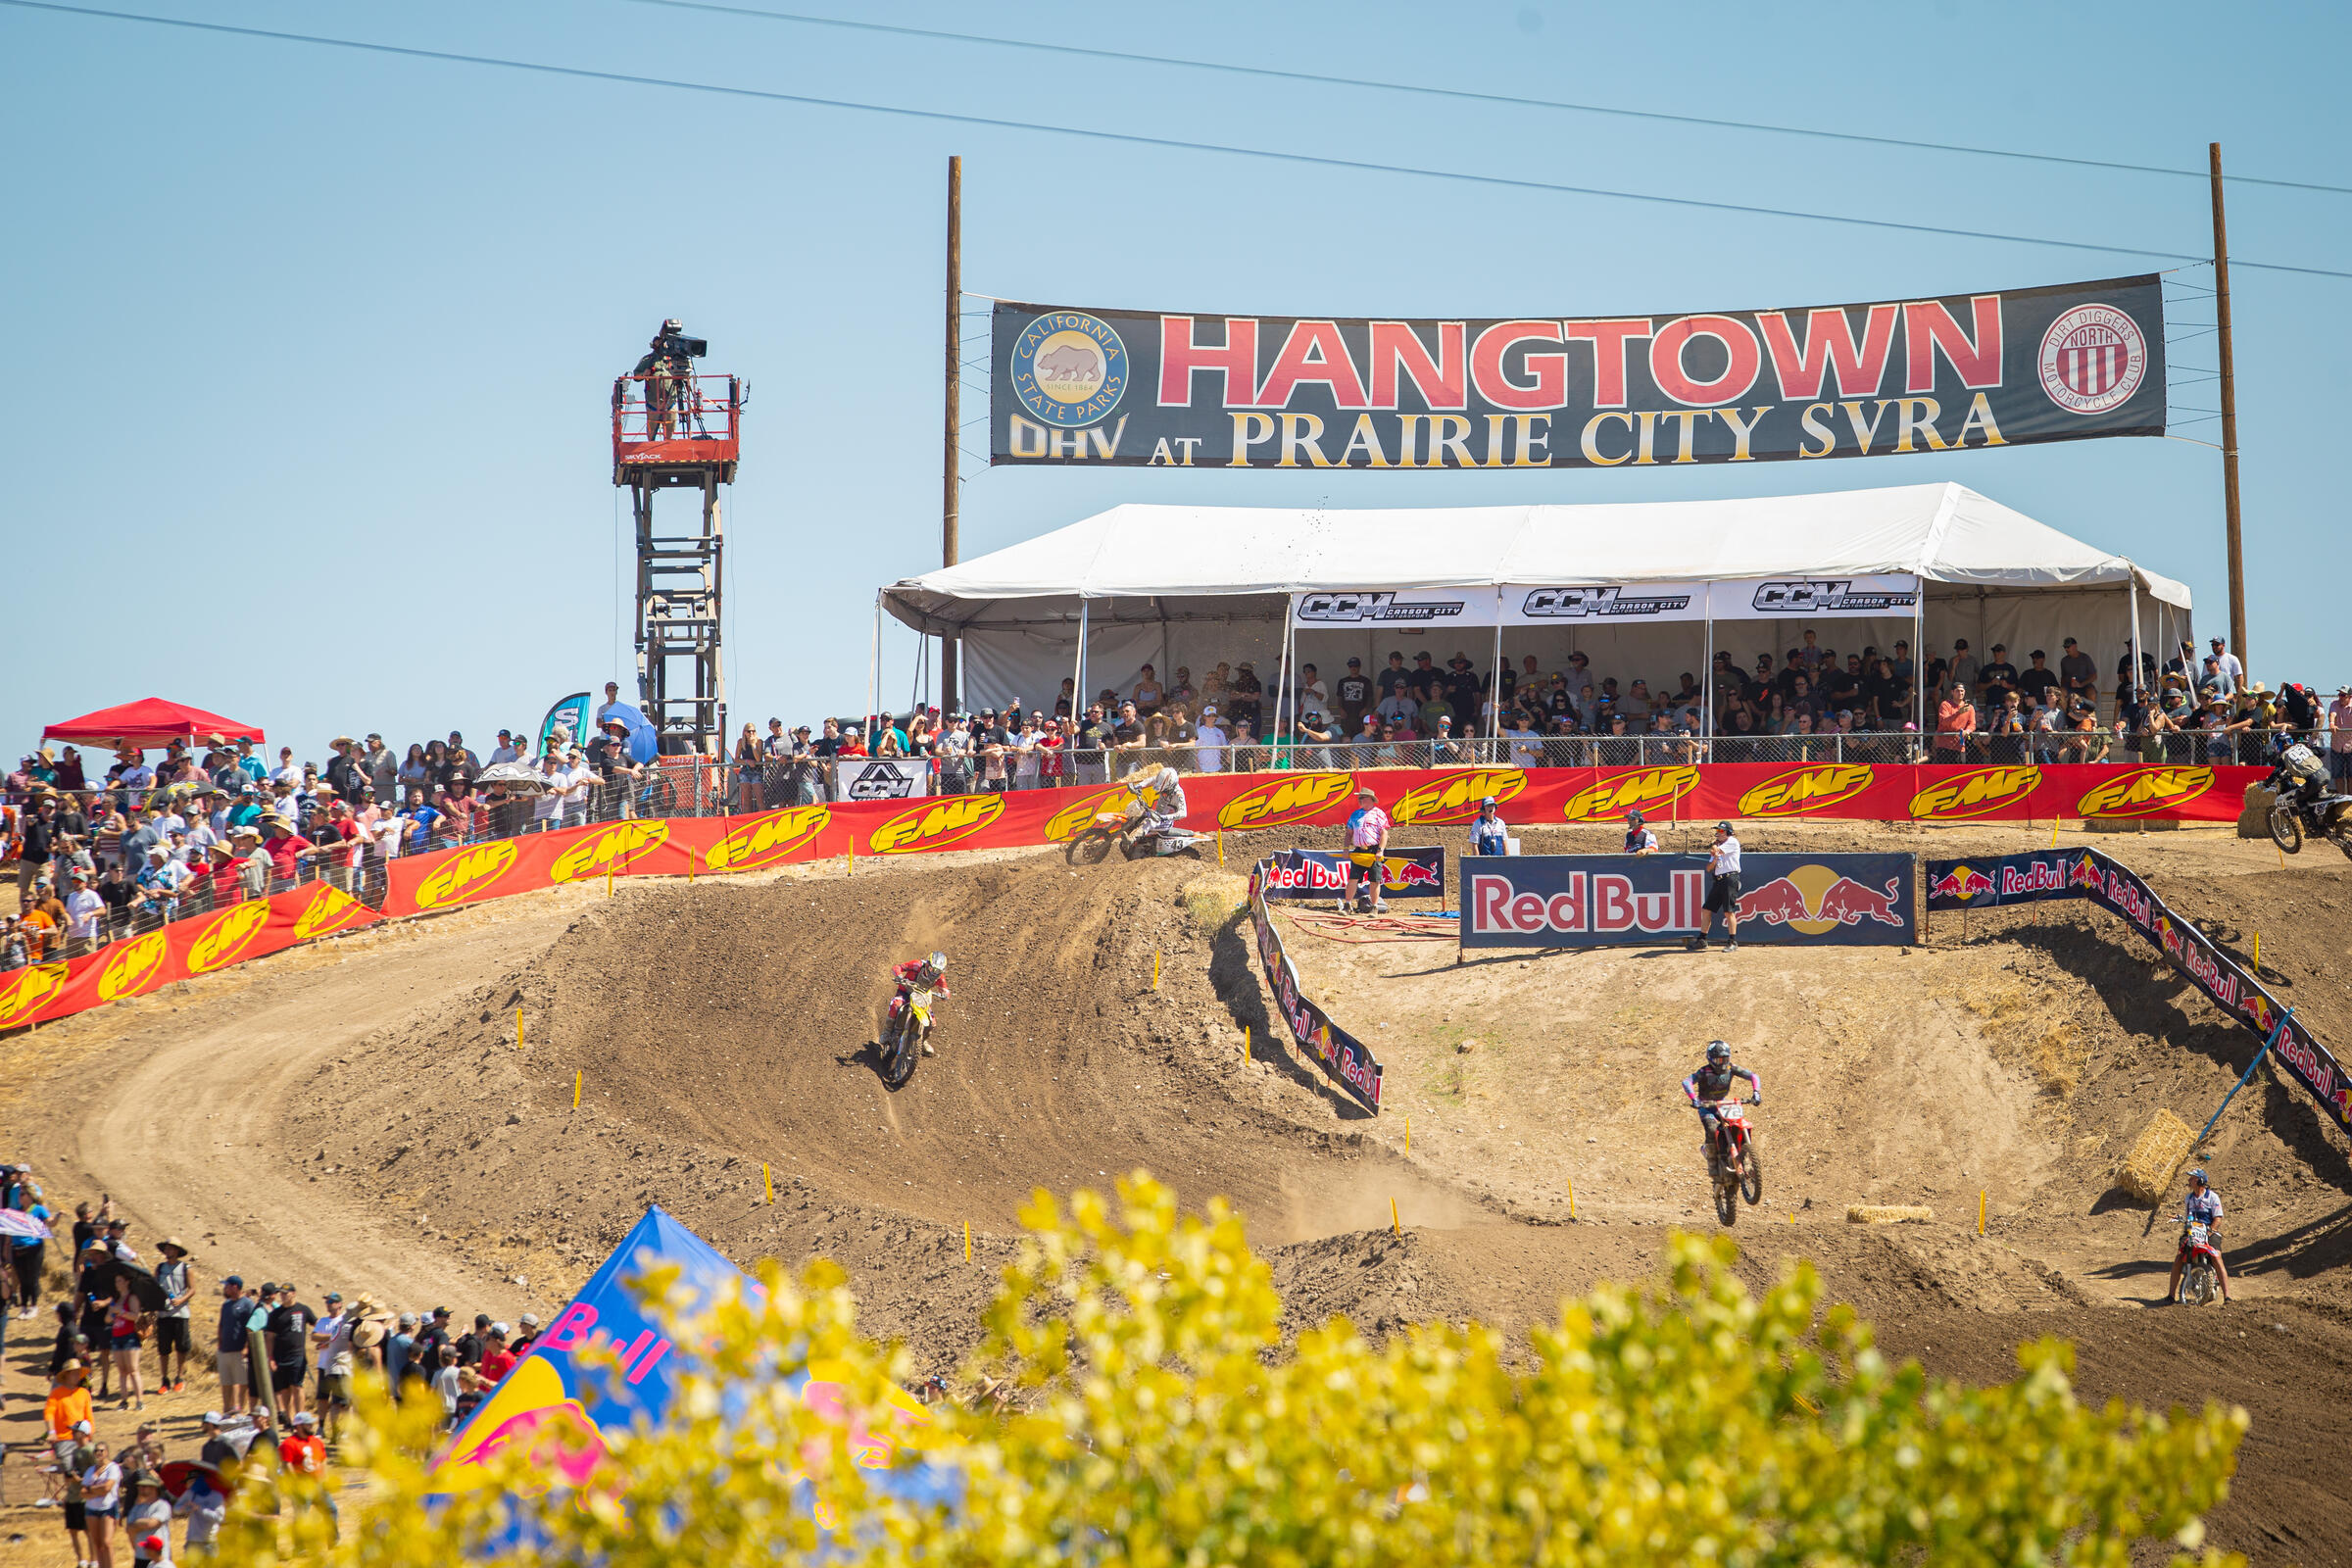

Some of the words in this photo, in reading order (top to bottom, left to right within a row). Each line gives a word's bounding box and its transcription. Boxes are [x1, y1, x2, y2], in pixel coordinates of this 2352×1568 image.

[1019, 316, 1120, 361] CALIFORNIA
[1156, 294, 2003, 411] HANGTOWN
[2048, 317, 2075, 348] DIRT
[2079, 311, 2134, 341] DIGGERS
[2070, 327, 2114, 347] NORTH
[1017, 372, 1066, 419] STATE
[1076, 375, 1121, 419] PARKS
[2044, 362, 2119, 409] MOTORCYCLE
[2120, 355, 2141, 391] CLUB
[1147, 437, 1202, 466] AT
[1225, 412, 1552, 467] PRAIRIE
[1581, 405, 1775, 466] CITY
[1799, 392, 2010, 455] SVRA
[1299, 593, 1394, 620] CCM
[1525, 588, 1619, 615] CCM
[1755, 582, 1849, 611] CCM
[851, 780, 913, 798] CCM
[1222, 771, 1352, 828] FMF
[1394, 768, 1525, 824] FMF
[1566, 764, 1697, 821] FMF
[1741, 764, 1872, 816] FMF
[1911, 764, 2039, 819] FMF
[2080, 765, 2213, 816] FMF
[709, 804, 828, 871] FMF
[874, 793, 1002, 854] FMF
[419, 838, 514, 909] FMF
[556, 819, 666, 884] FMF
[189, 899, 270, 973] FMF
[100, 929, 166, 1002] FMF
